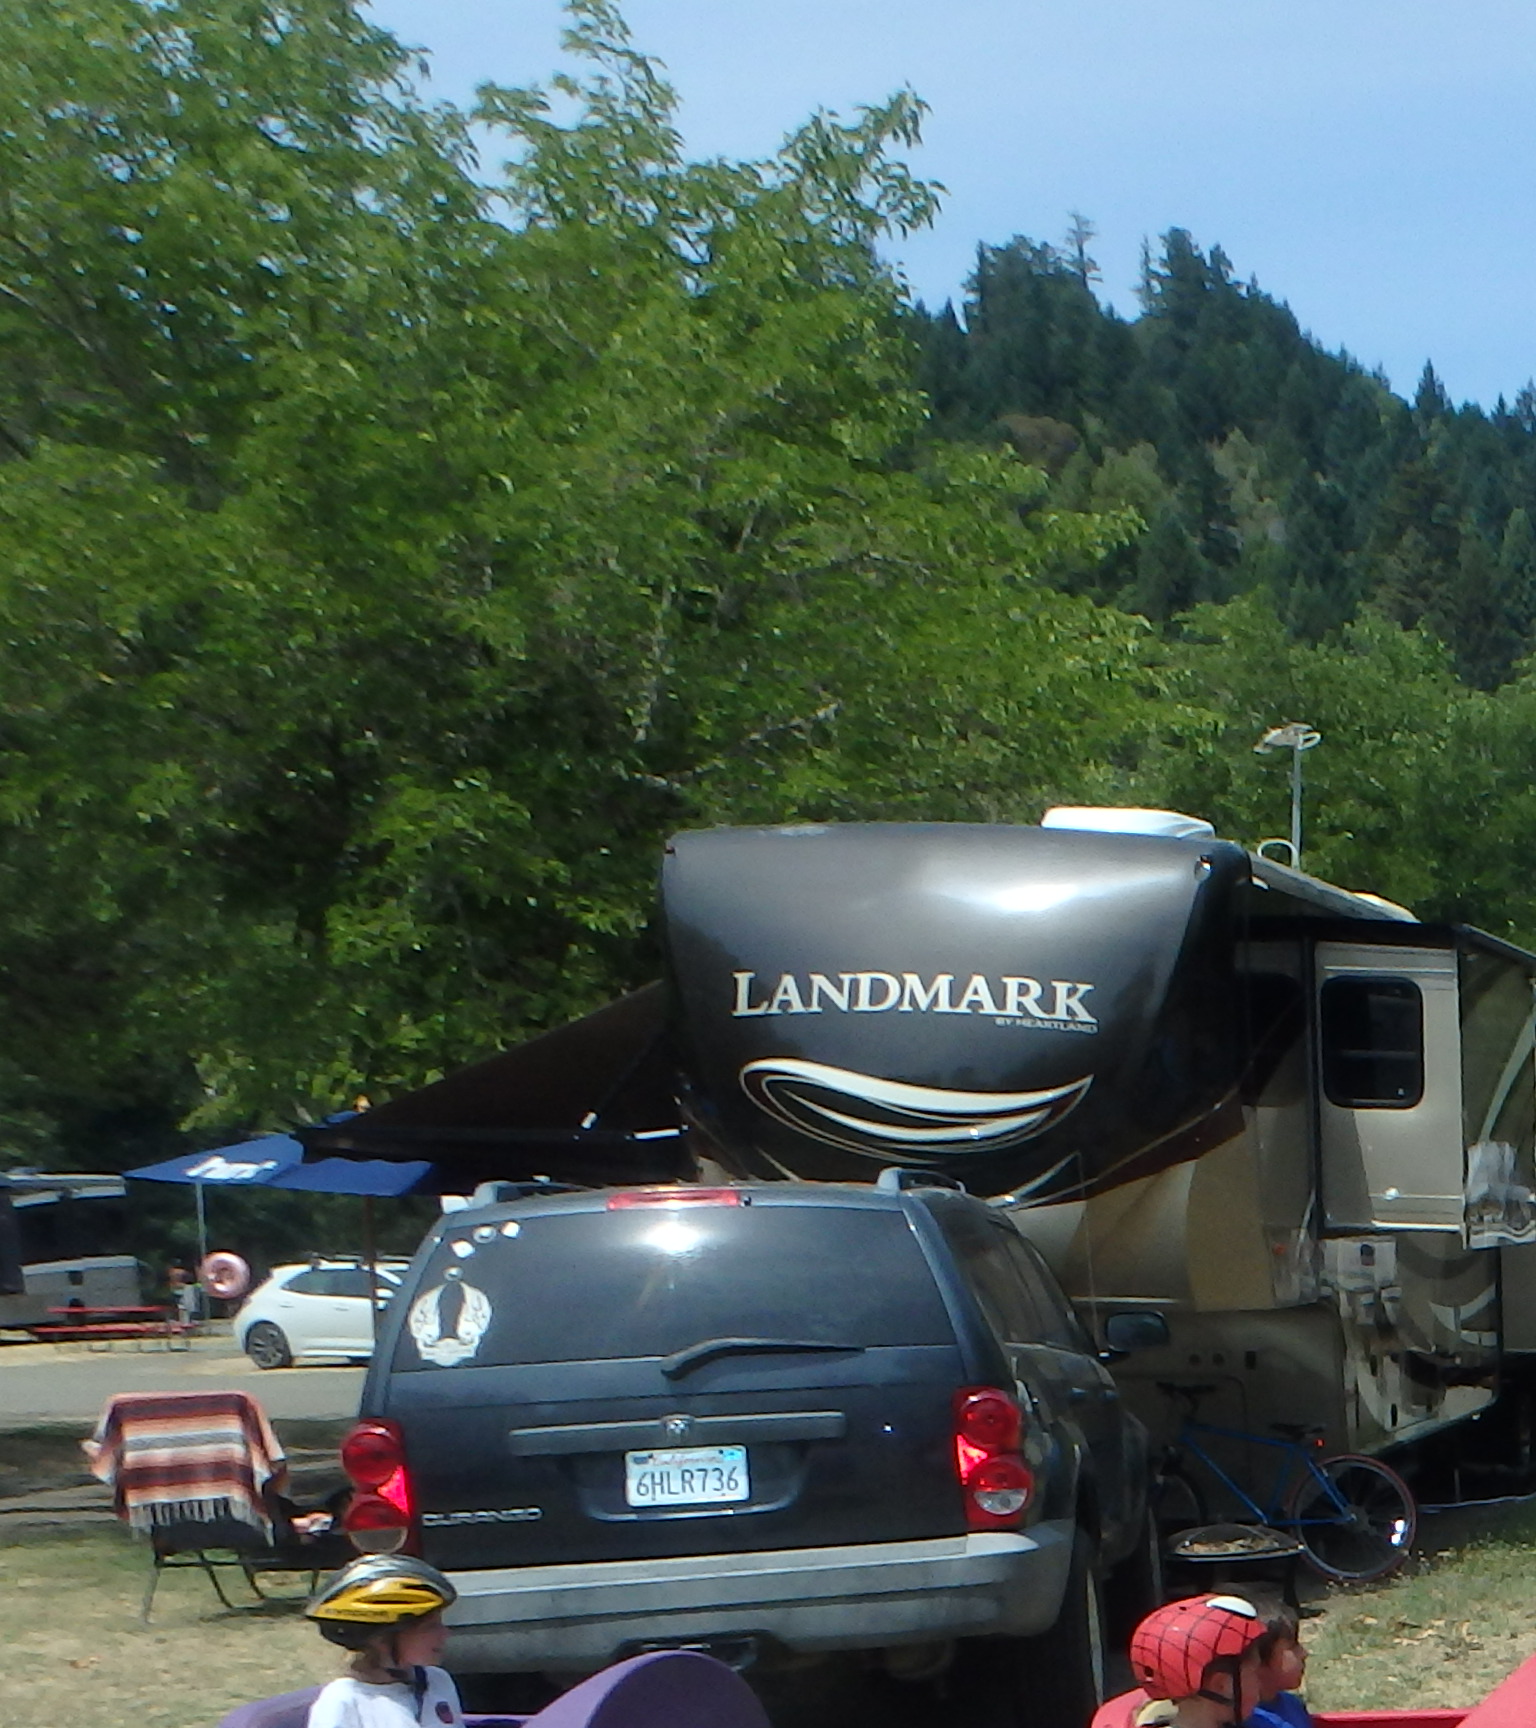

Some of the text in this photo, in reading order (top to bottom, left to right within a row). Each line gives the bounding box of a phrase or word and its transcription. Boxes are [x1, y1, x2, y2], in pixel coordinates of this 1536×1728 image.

[731, 971, 1098, 1024] LANDMARK
[636, 1466, 739, 1497] 6HLR736
[421, 1507, 542, 1527] DURANGO
